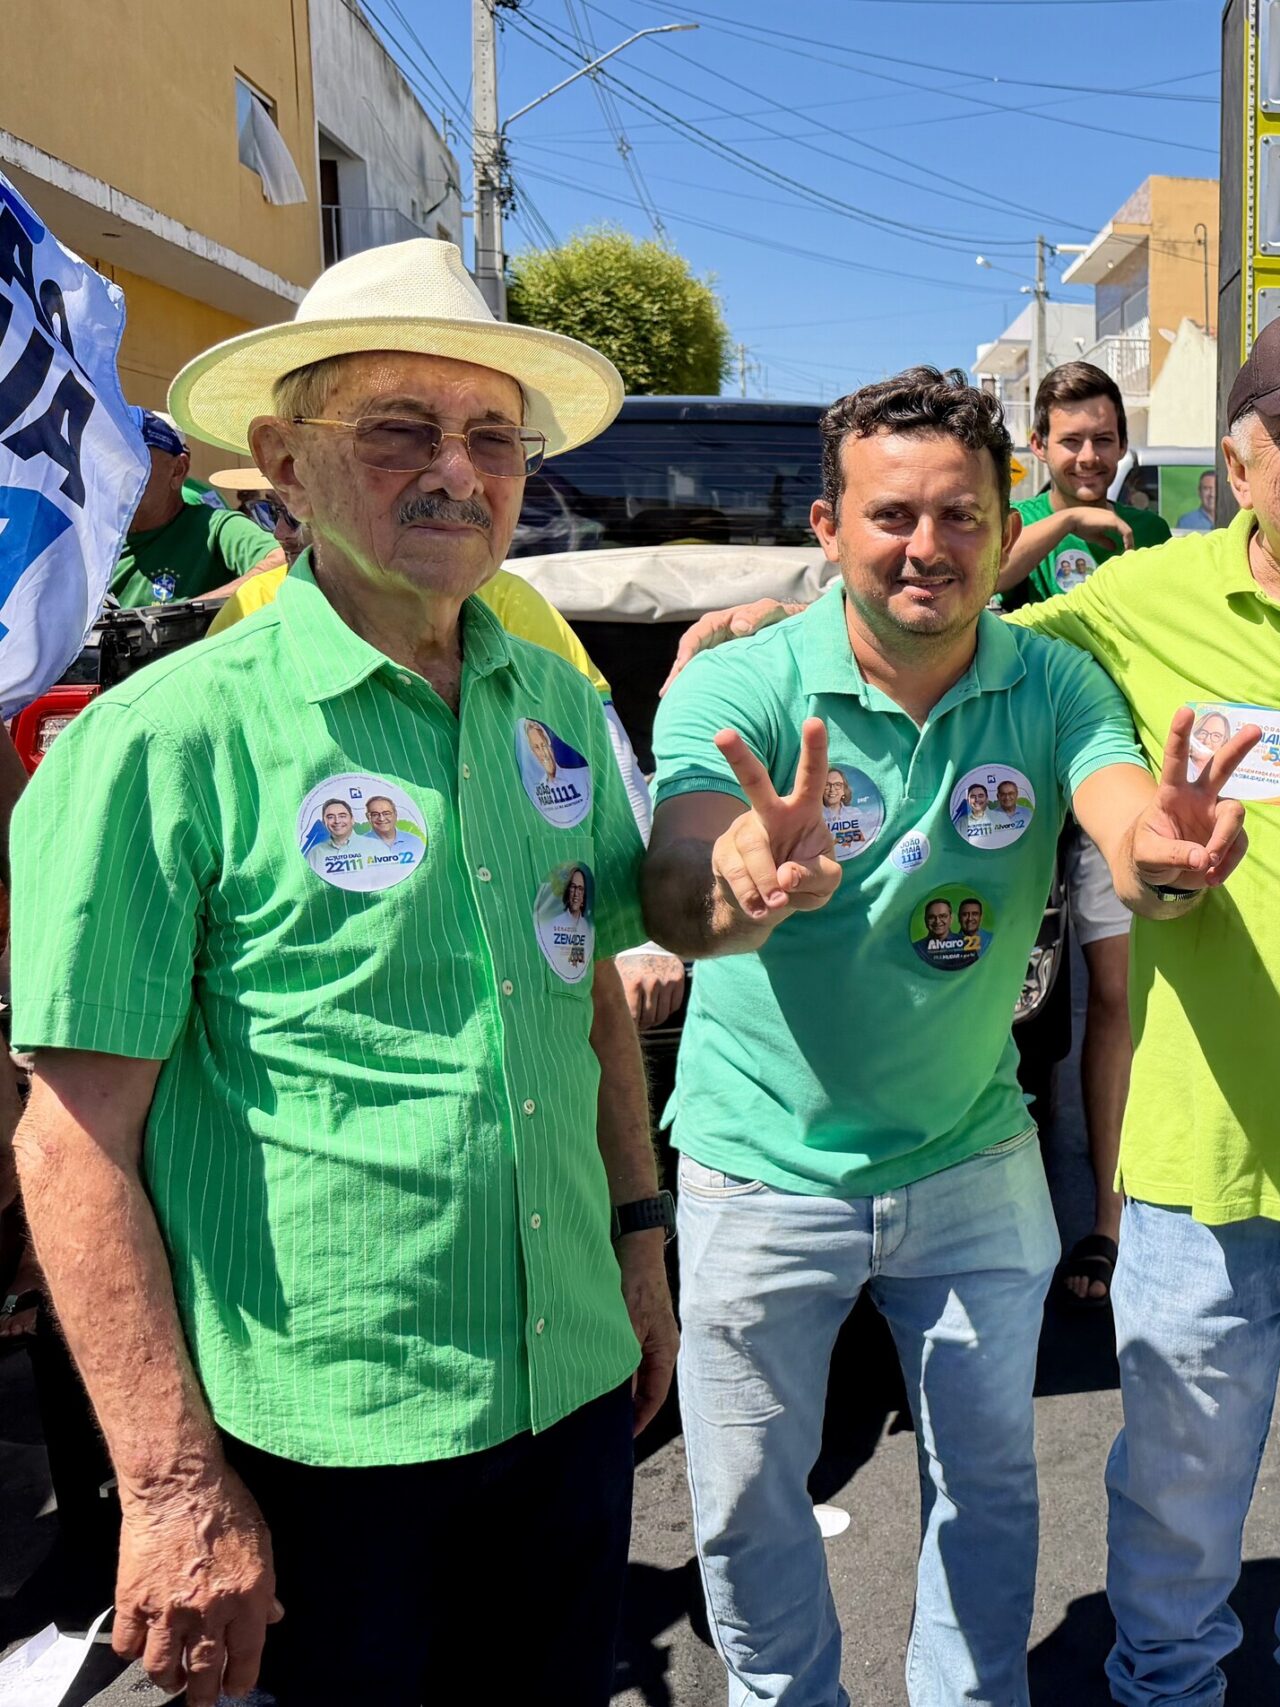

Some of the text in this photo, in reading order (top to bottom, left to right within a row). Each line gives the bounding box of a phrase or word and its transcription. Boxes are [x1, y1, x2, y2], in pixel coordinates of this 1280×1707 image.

[551, 784, 582, 804] 1111
[967, 827, 993, 837] 22111
[1014, 819, 1025, 830] 22
[836, 829, 861, 844] 555
[901, 838, 920, 849] JOÃO
[902, 845, 921, 855] MAIA
[902, 851, 922, 864] 1111
[325, 852, 415, 874] 22111 Alvaro 22
[928, 935, 982, 952] Alvaro 22
